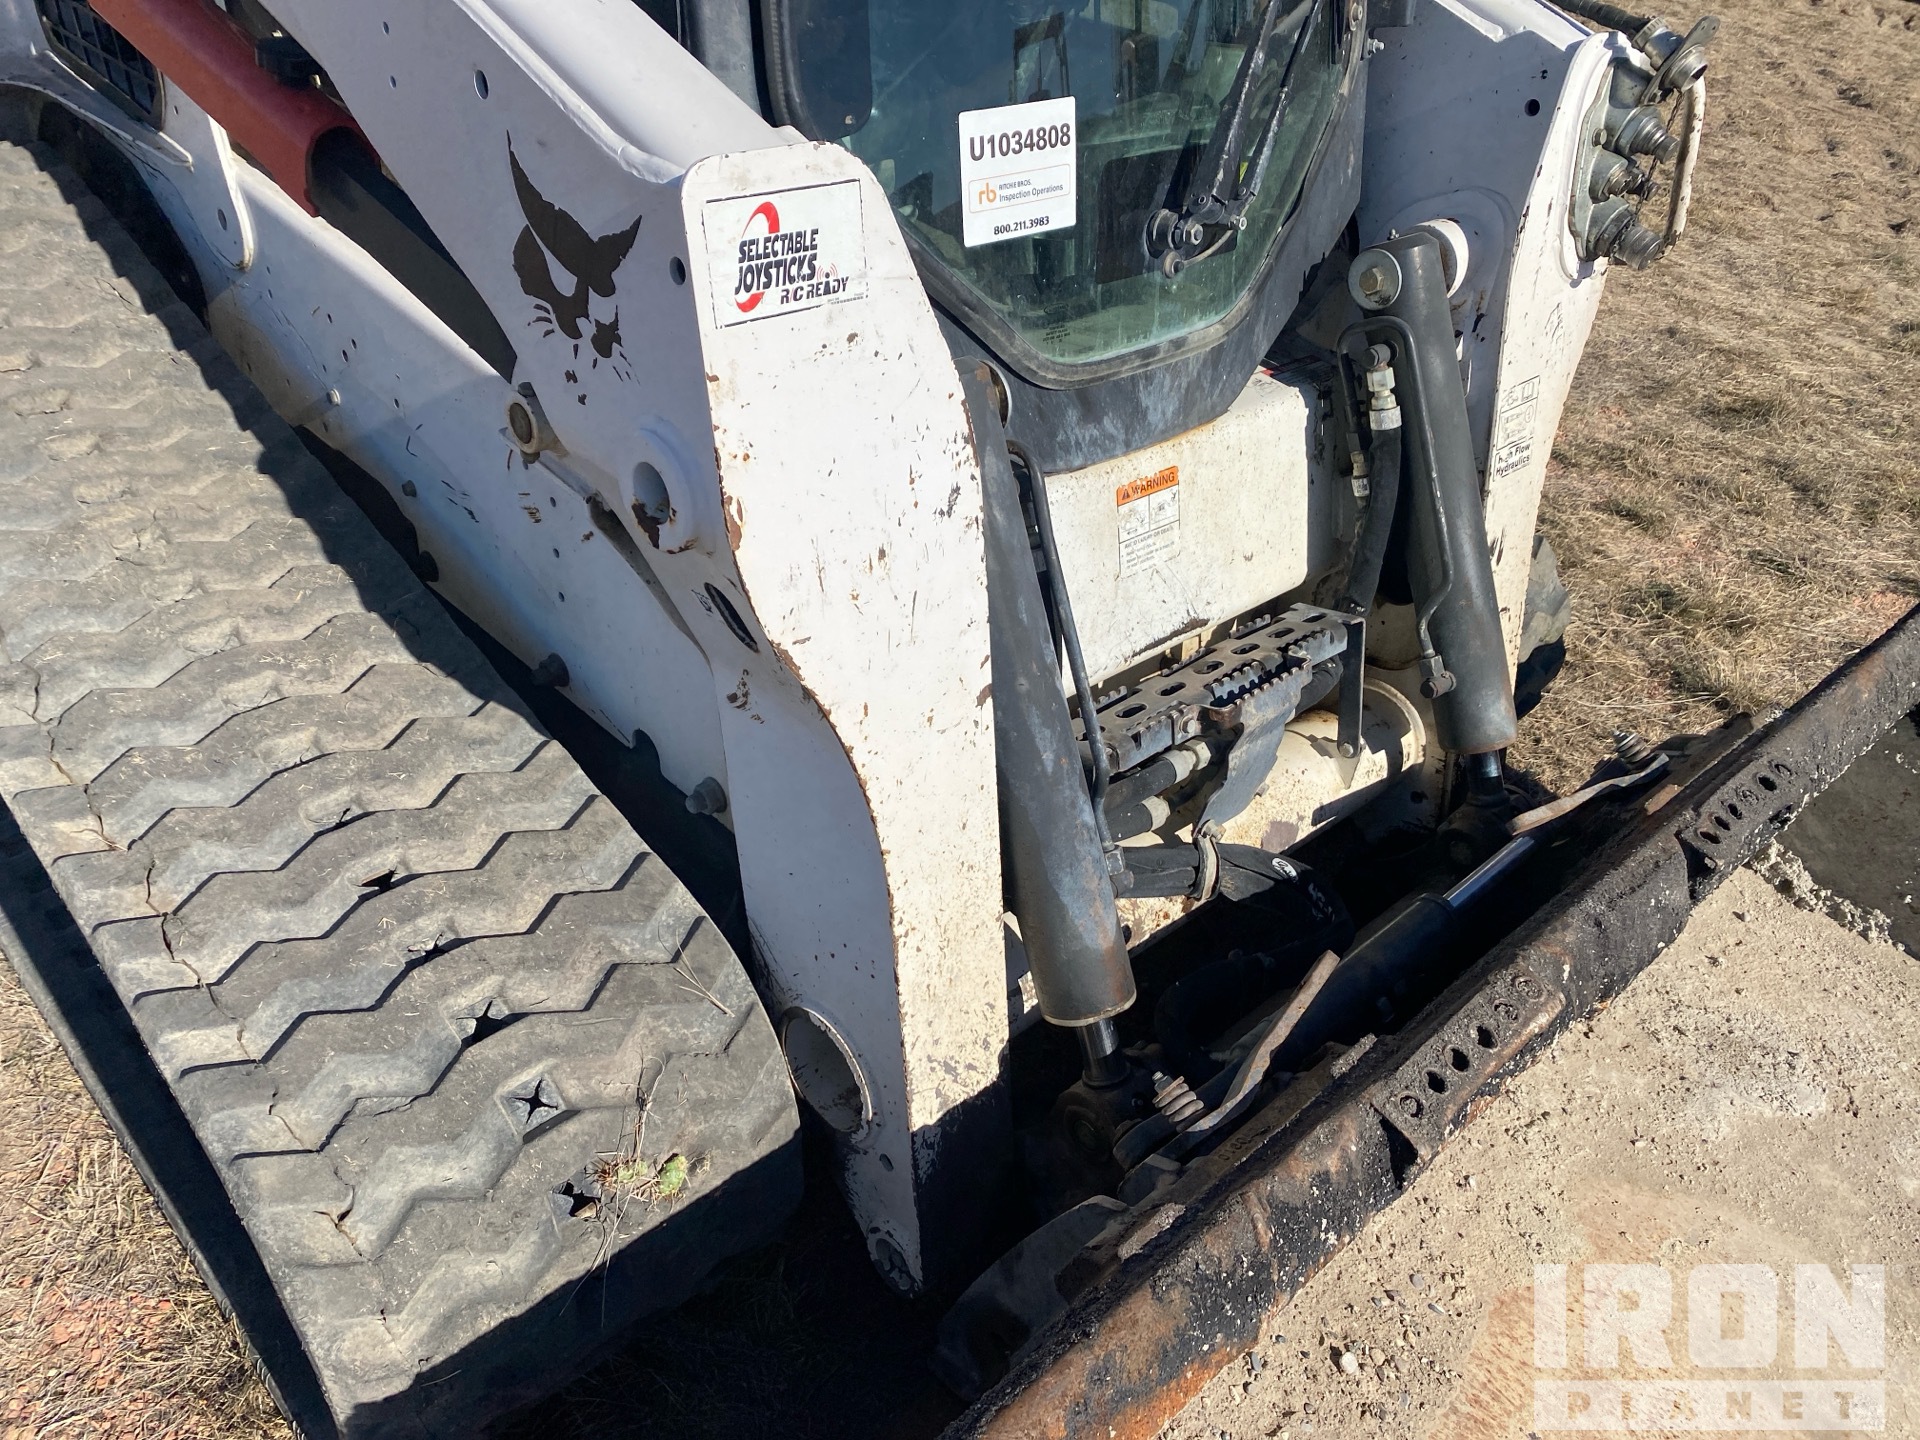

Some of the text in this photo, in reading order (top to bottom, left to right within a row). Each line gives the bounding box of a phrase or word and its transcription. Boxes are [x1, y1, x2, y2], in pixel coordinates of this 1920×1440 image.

[969, 122, 1071, 162] U1034808
[999, 184, 1064, 203] Inspection Operations
[993, 215, 1050, 236] 800.211.3983
[738, 228, 819, 264] SELECTABLE
[734, 253, 818, 296] JOYSTICKS
[806, 276, 850, 300] READY
[1514, 443, 1531, 456] Flow
[1496, 454, 1530, 476] Hydraulics
[1131, 471, 1175, 495] WARNING
